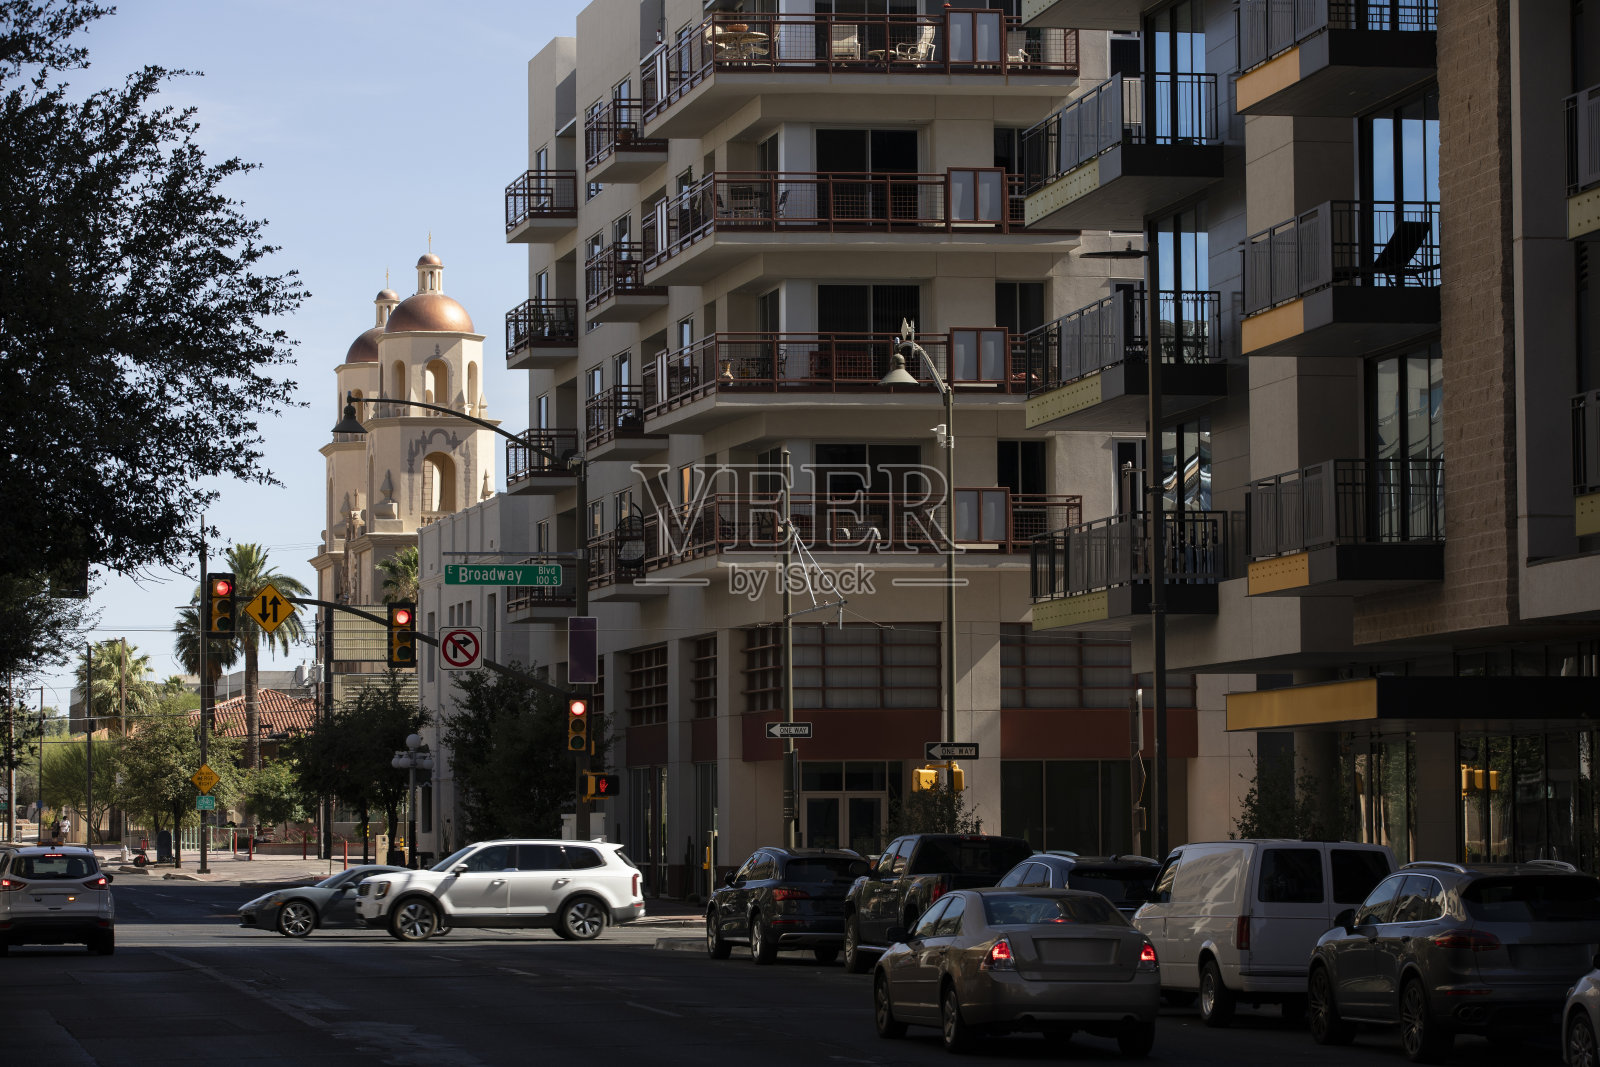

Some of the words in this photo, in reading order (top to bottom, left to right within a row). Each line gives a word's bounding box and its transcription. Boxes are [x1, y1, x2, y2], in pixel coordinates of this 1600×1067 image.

[447, 565, 453, 574] E
[458, 566, 523, 584] Broadway
[538, 566, 556, 575] Blvd
[536, 575, 550, 585] 100
[552, 575, 558, 585] S
[941, 747, 956, 755] ONE
[958, 747, 974, 755] WAY
